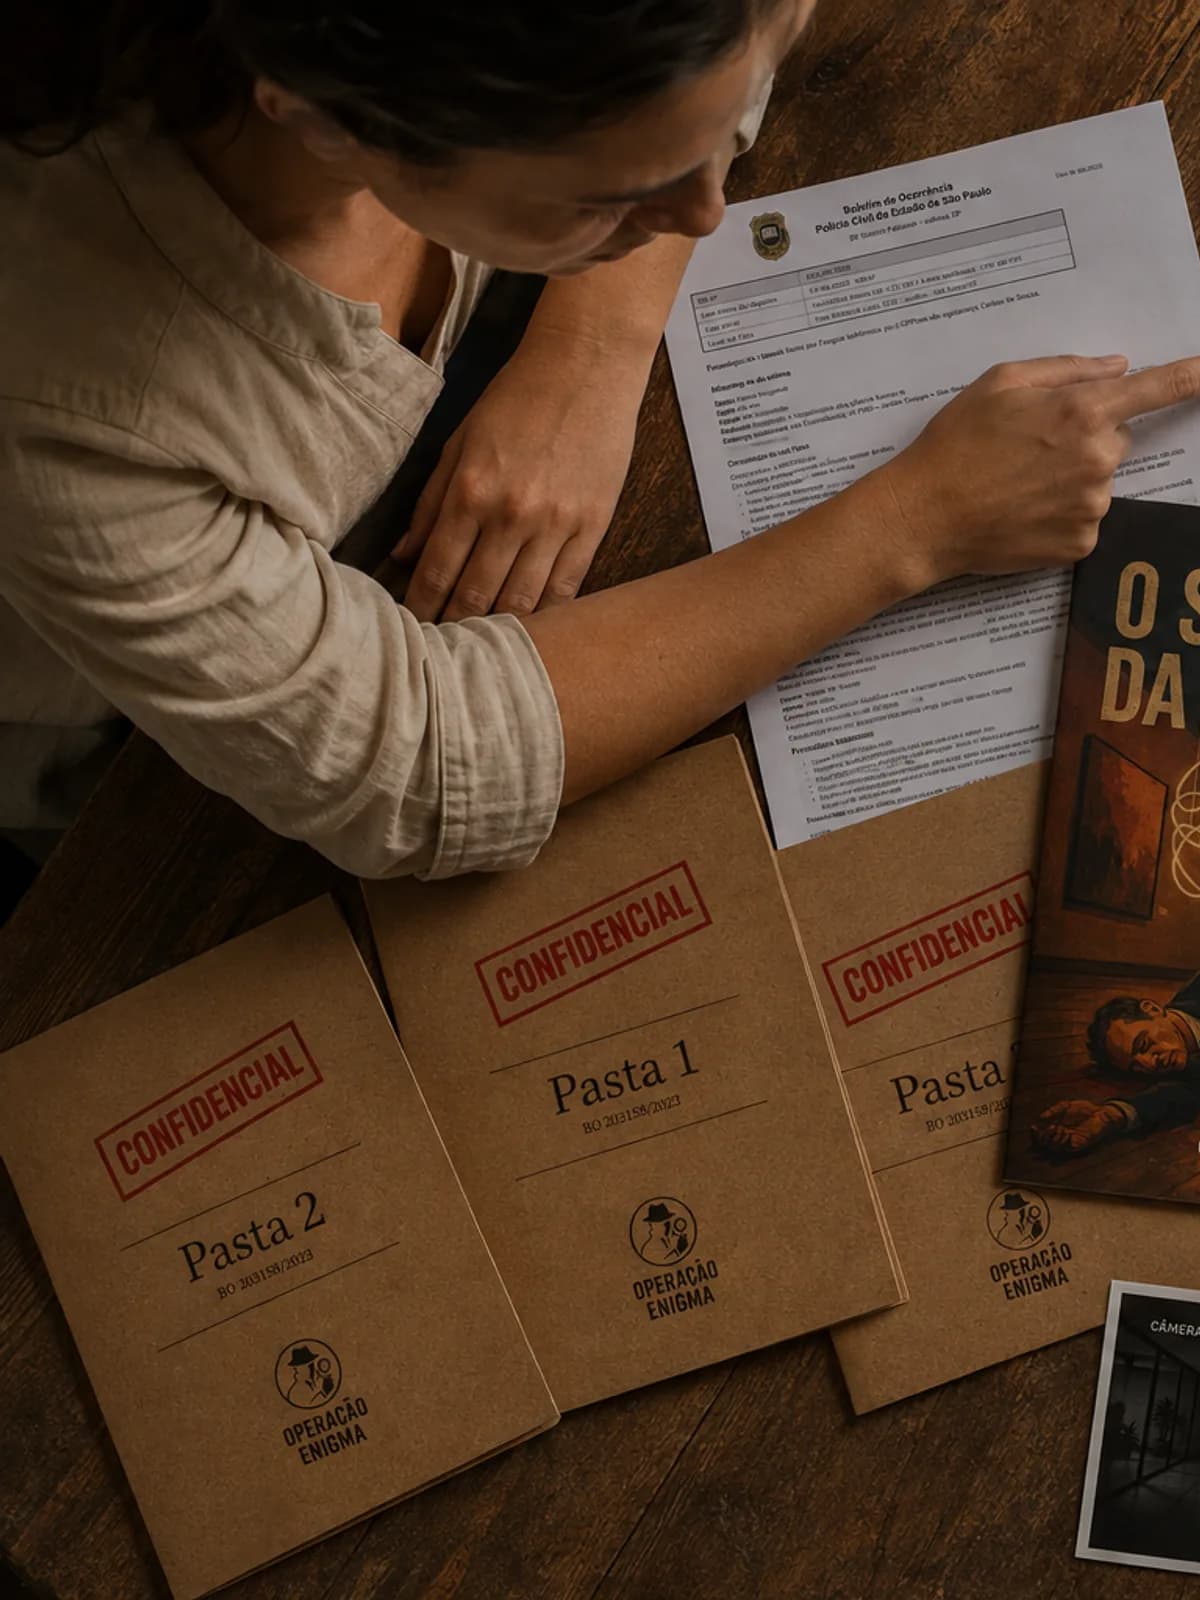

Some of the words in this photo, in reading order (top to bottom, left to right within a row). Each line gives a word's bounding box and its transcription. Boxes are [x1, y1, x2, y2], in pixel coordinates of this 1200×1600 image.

[1114, 560, 1159, 639] O
[1100, 646, 1186, 728] DA
[496, 884, 694, 1005] CONFIDENCIAL
[115, 1044, 305, 1178] CONFIDENCIAL
[548, 1060, 666, 1115] Pasta
[673, 1040, 699, 1077] 1
[890, 1061, 1008, 1114] Pasta
[178, 1218, 294, 1283] Pasta
[295, 1192, 326, 1232] 2
[646, 1284, 716, 1321] ENIGMA
[1003, 1266, 1070, 1301] ENIGMA
[298, 1423, 369, 1466] ENIGMA
